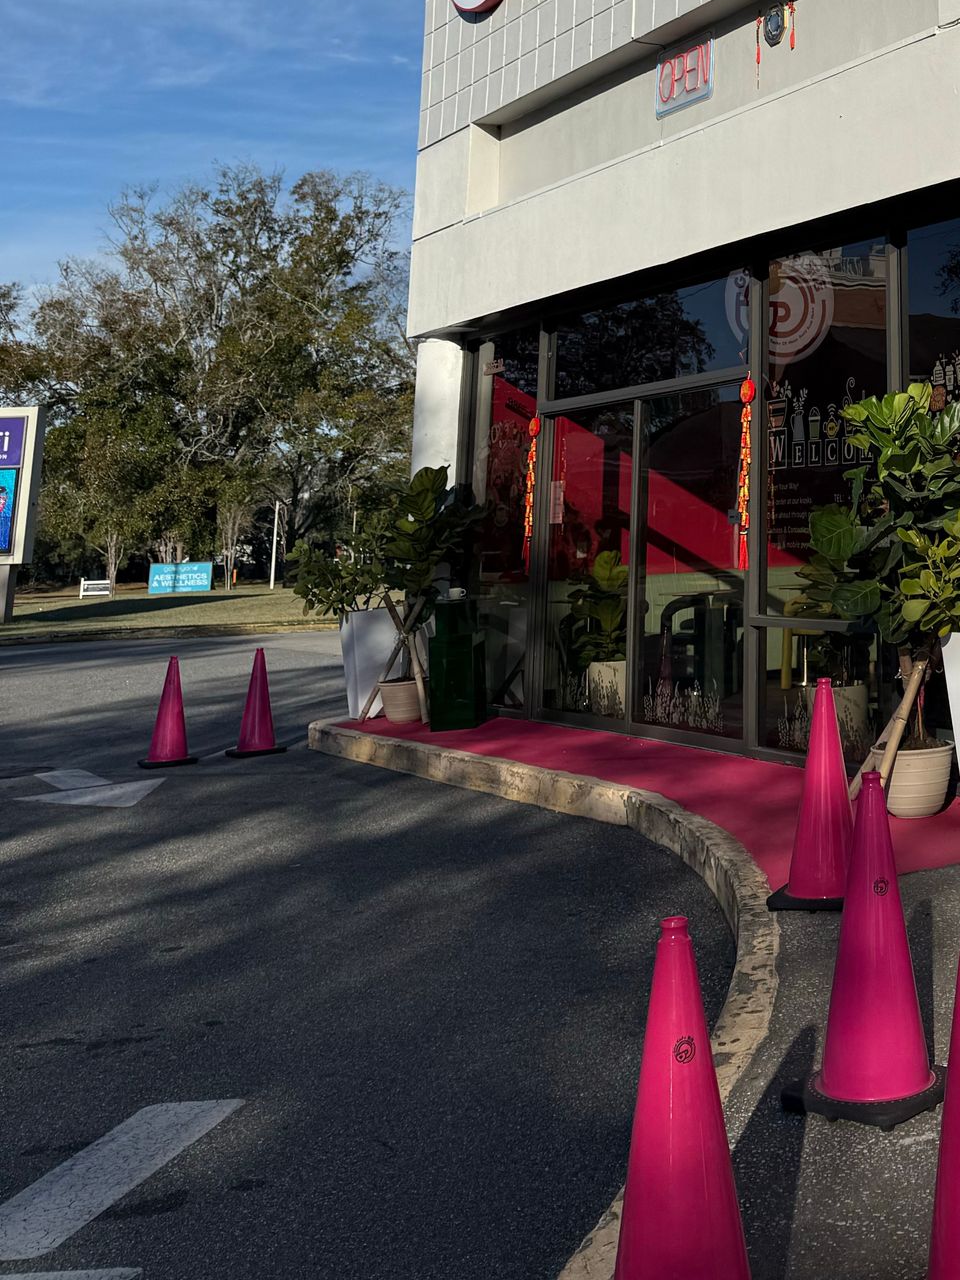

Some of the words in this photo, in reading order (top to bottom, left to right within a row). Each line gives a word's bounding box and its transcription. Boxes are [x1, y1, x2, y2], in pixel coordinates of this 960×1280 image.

[659, 40, 711, 103] OPEN
[154, 573, 208, 581] AESTHETICS
[161, 579, 208, 587] WELLNESS
